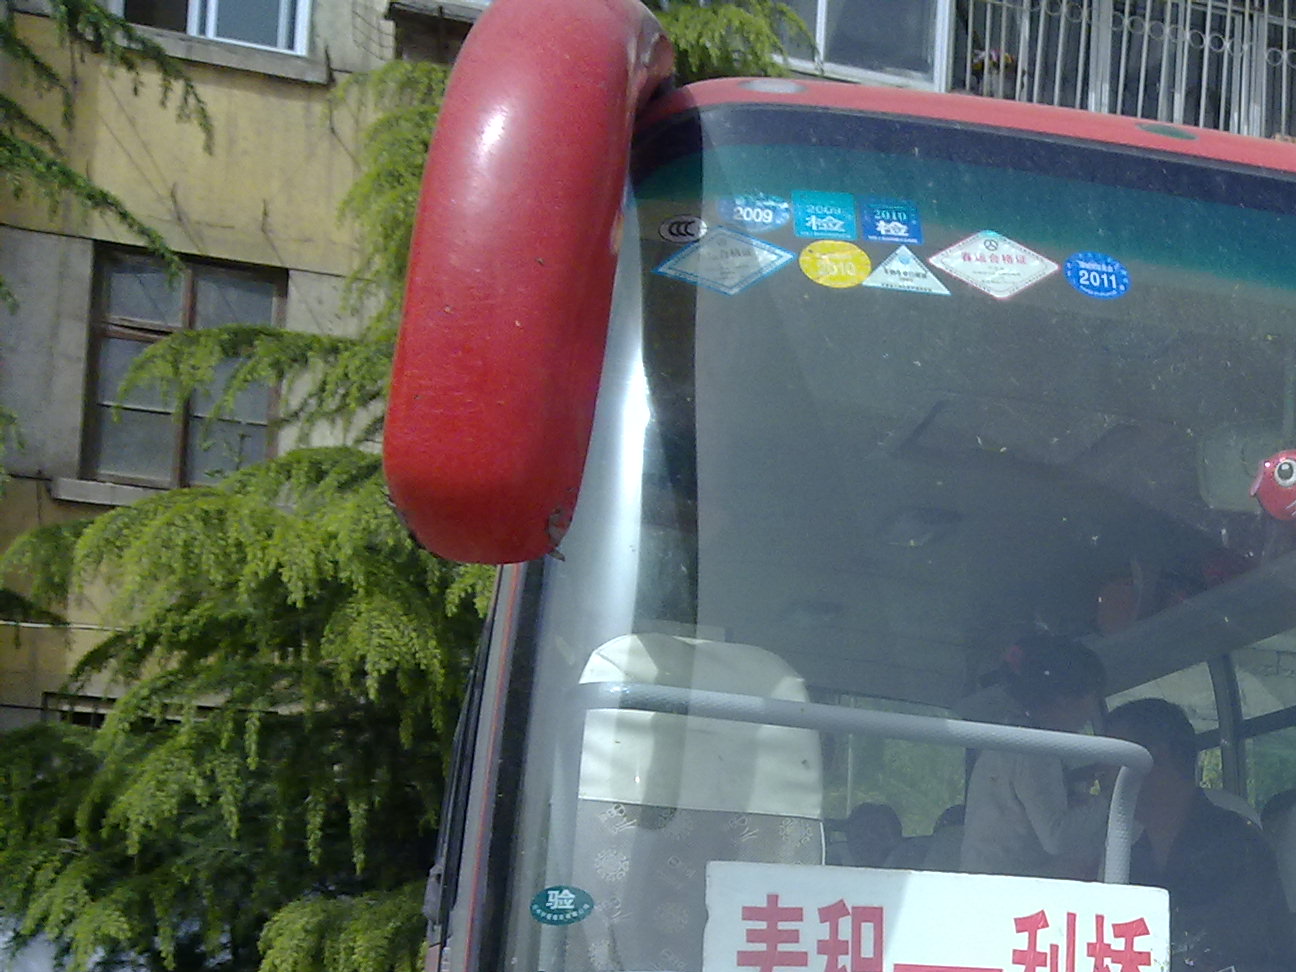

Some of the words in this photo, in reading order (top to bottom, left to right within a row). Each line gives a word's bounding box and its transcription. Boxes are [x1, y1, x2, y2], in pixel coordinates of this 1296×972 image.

[733, 206, 773, 223] 2009
[1079, 269, 1116, 289] 2011
[545, 889, 576, 910] 验
